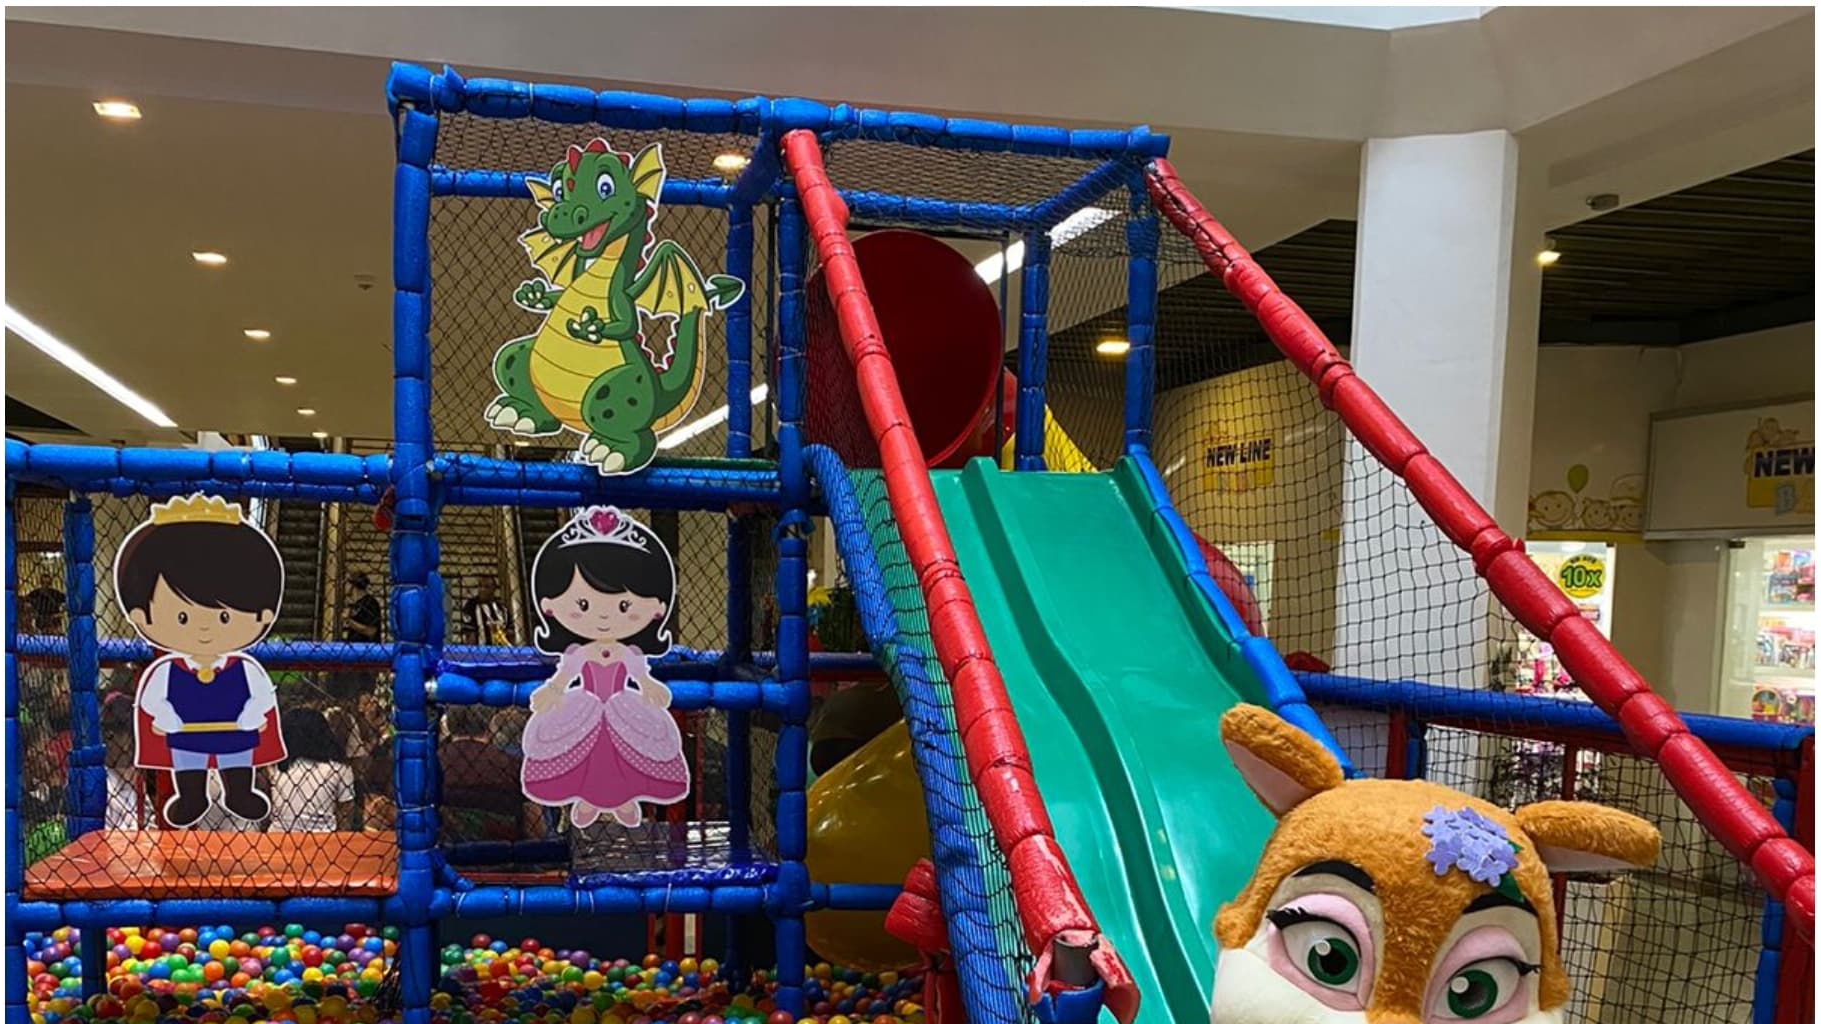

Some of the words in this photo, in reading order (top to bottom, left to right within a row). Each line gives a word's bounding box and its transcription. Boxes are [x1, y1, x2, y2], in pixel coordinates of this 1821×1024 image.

[1205, 442, 1238, 468] NEW
[1239, 437, 1272, 463] LINE
[1753, 448, 1815, 478] NEW
[1561, 565, 1602, 588] 10x
